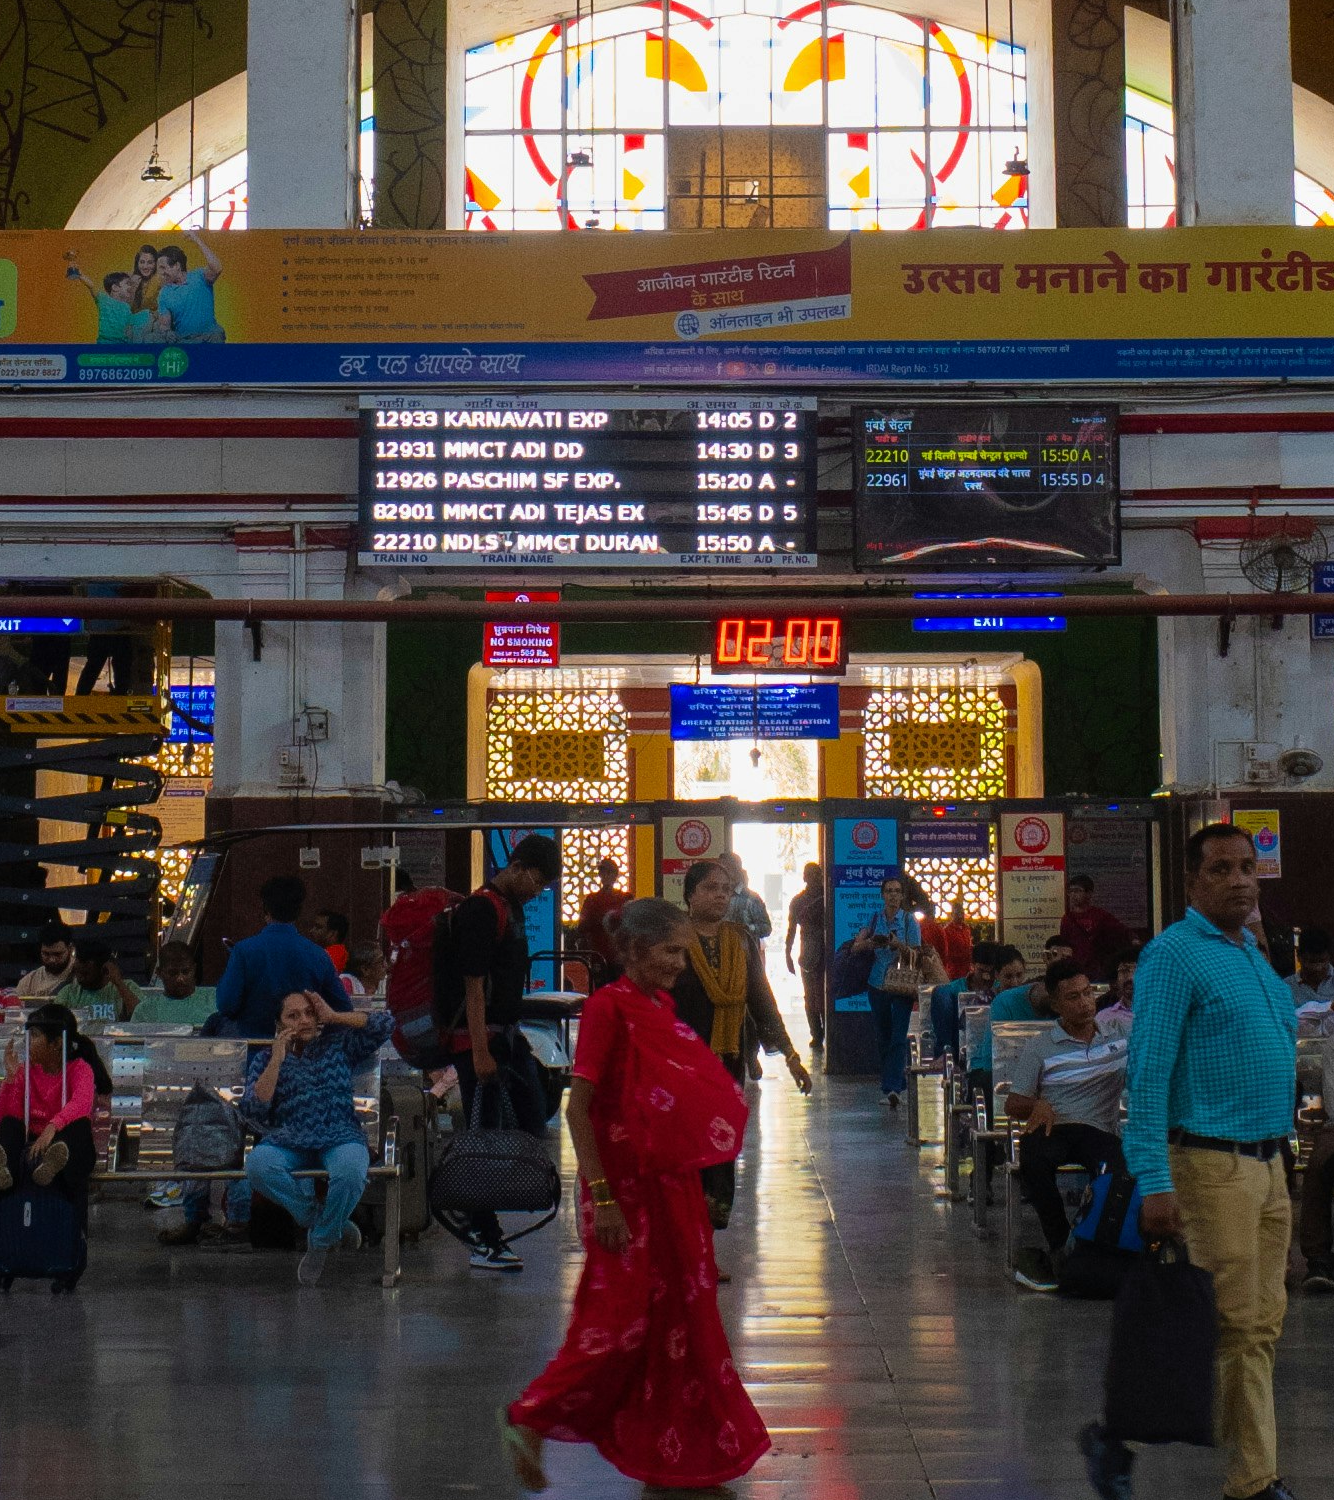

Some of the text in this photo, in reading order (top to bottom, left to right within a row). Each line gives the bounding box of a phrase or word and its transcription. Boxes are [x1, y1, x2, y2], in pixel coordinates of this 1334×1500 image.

[637, 259, 796, 294] आजीवन गारंटीड रिटर्न
[901, 262, 1004, 296] उत्सव
[1014, 251, 1130, 294] मनाने
[1138, 262, 1190, 293] का
[691, 289, 745, 308] के साथ
[709, 304, 846, 331] ऑनलाइन भी उपलब्ध
[338, 348, 526, 377] हर पल आपके साथ
[933, 363, 949, 374] 512
[79, 368, 153, 381] 8976862090
[496, 400, 539, 409] का नाम
[375, 411, 797, 428] 12933 KARNAVATI EXP 14:05 D 2
[864, 417, 912, 432] मुंबई सेंट्रल
[375, 441, 798, 458] 12931 MMCT ADI DD 14:30 D 3
[866, 449, 909, 463] 22210
[1040, 449, 1091, 463] 15:50 A
[375, 472, 776, 489] 12926 PASCHIM SF EXP. 15:20 A
[866, 473, 908, 487] 22961
[1040, 473, 1104, 487] 15:55 D 4
[373, 503, 798, 524] 82901 MMCT ADI TEJAS EX 15:45 D 5
[373, 533, 776, 550] 22210 NDLS MMCT DURAN 15:50 A
[373, 554, 428, 563] TRAIN NO
[481, 554, 555, 563] TRAIN NAME
[680, 554, 742, 564] EXPT. TIME
[753, 554, 773, 564] A/D
[490, 638, 553, 648] NO SMOKING
[681, 718, 831, 726] GREEN STATION CLEAN STATION
[845, 867, 863, 879] मुंबई
